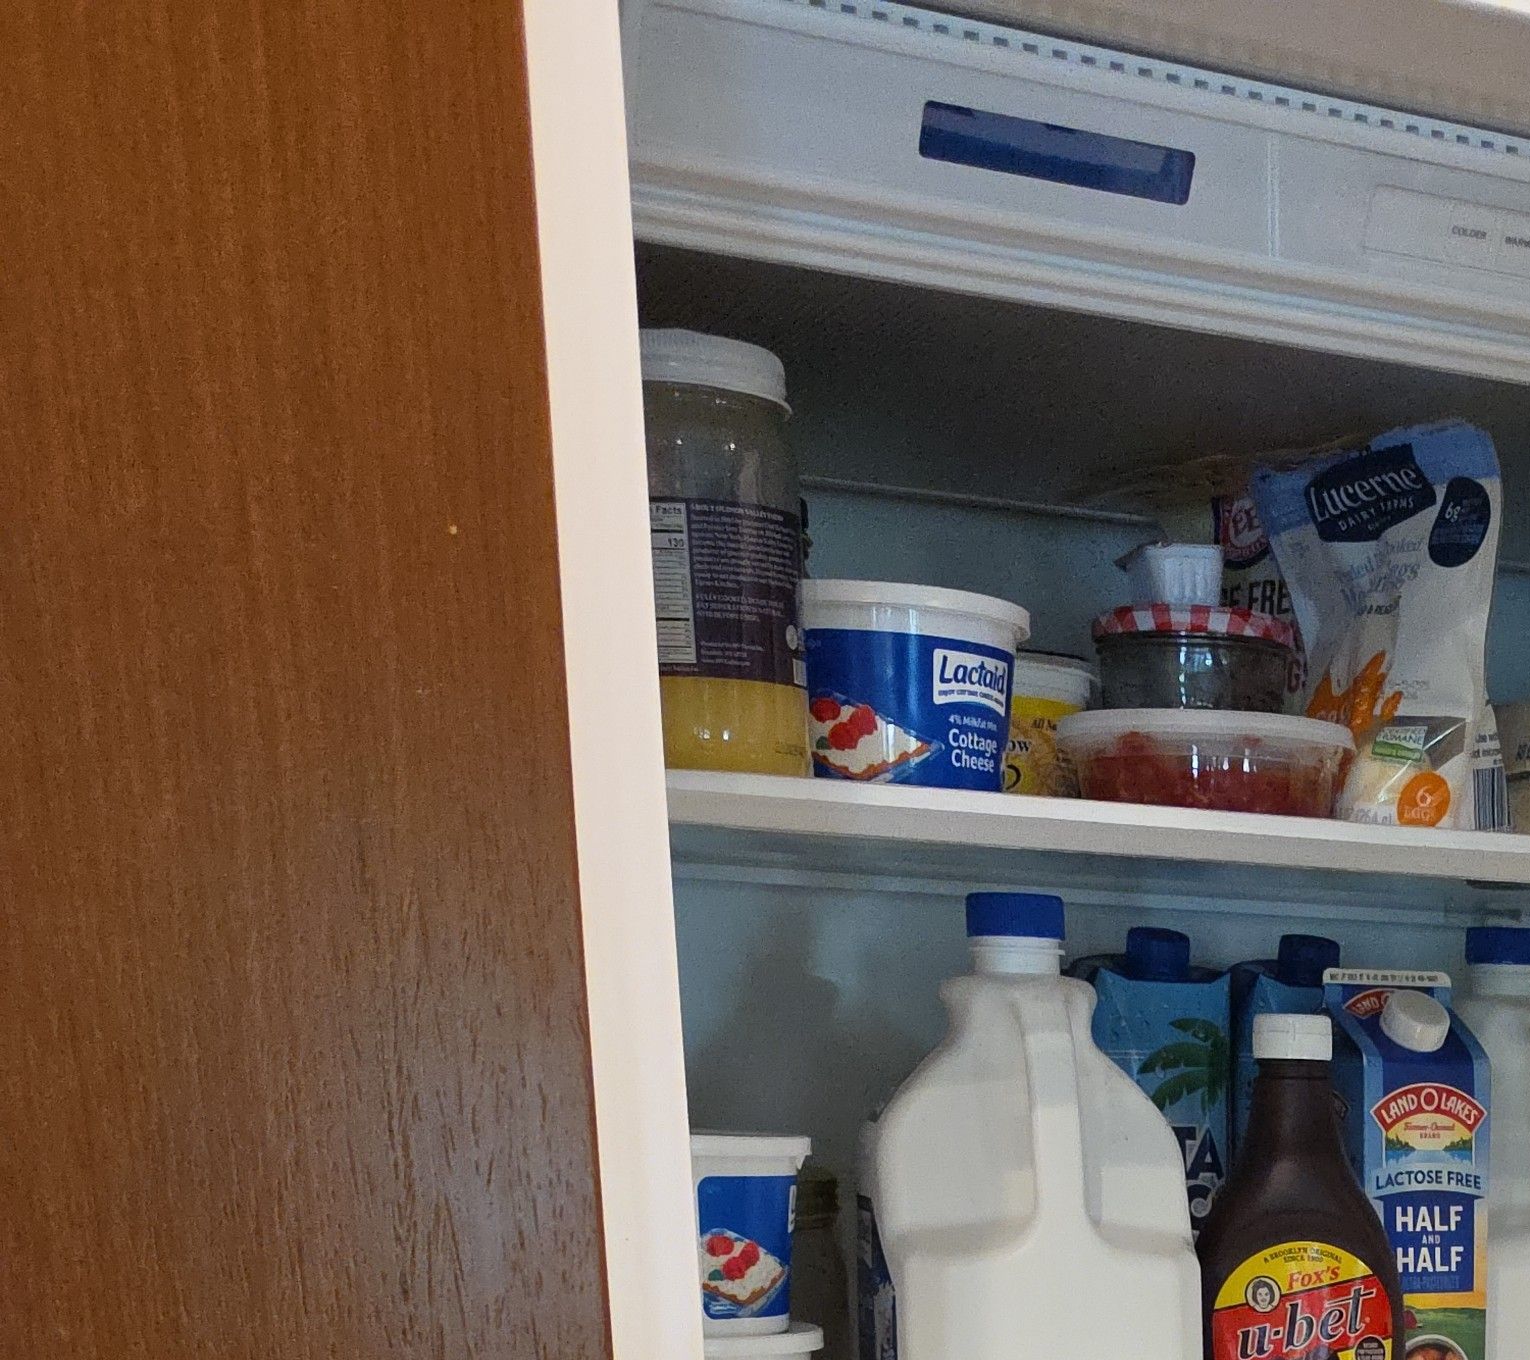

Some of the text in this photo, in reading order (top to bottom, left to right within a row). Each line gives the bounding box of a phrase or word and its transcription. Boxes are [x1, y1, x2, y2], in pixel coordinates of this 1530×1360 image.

[1309, 467, 1423, 522] Lucerne
[939, 654, 1006, 696] Lactaid
[948, 728, 998, 758] Cottage
[951, 749, 995, 773] Cheese
[1380, 1087, 1480, 1125] LAND O LAKES
[1375, 1169, 1482, 1191] LACTOSE FREE
[1395, 1205, 1464, 1232] HALF
[1421, 1233, 1441, 1245] AND
[1396, 1245, 1465, 1273] HALF
[1286, 1264, 1341, 1291] Fox's
